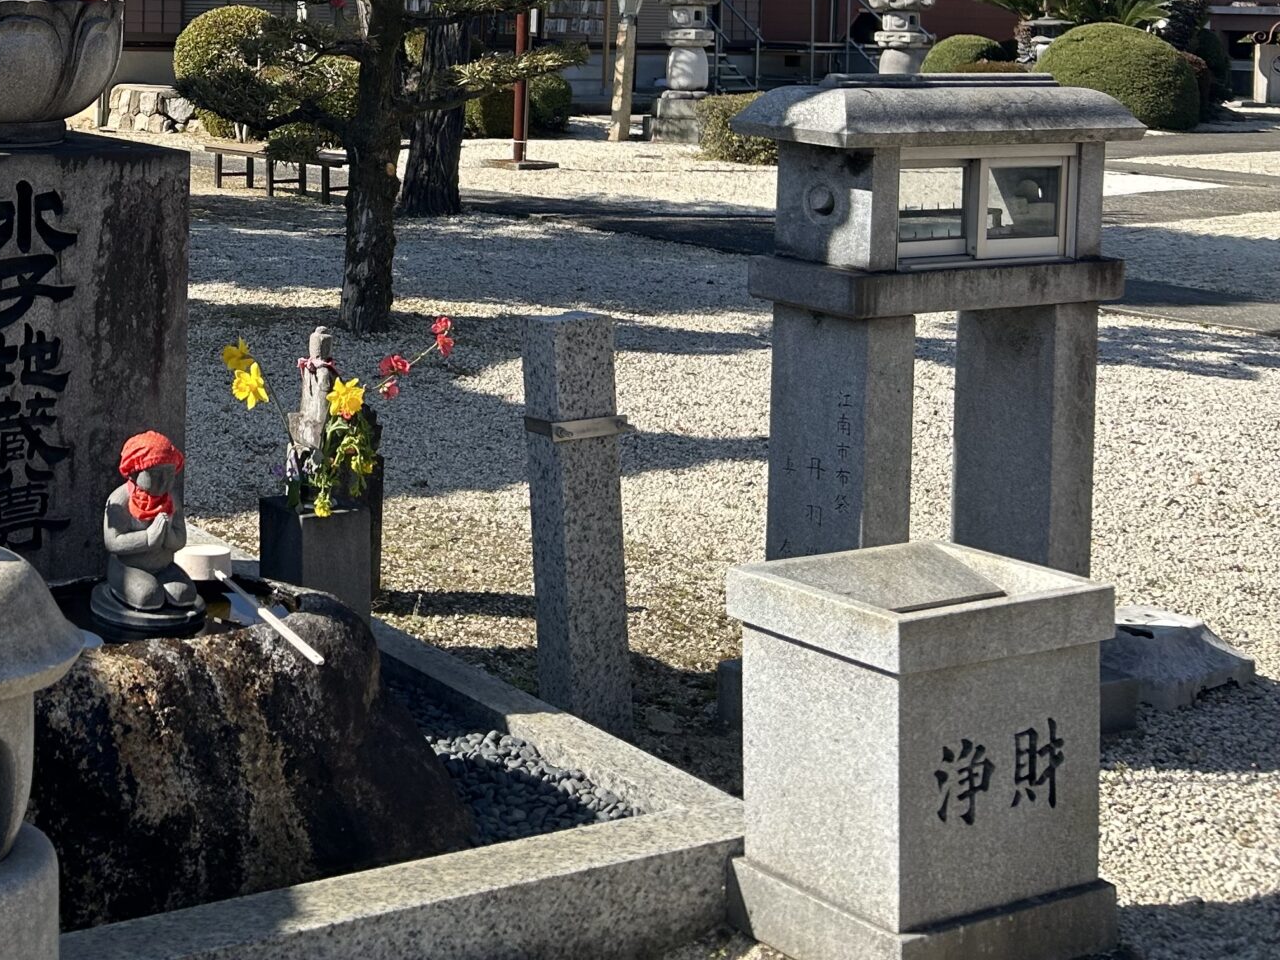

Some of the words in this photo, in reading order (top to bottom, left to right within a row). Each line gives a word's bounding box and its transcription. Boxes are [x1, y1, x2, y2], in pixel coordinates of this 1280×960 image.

[834, 392, 853, 514] 江南市布袋
[934, 716, 1065, 826] 浄財
